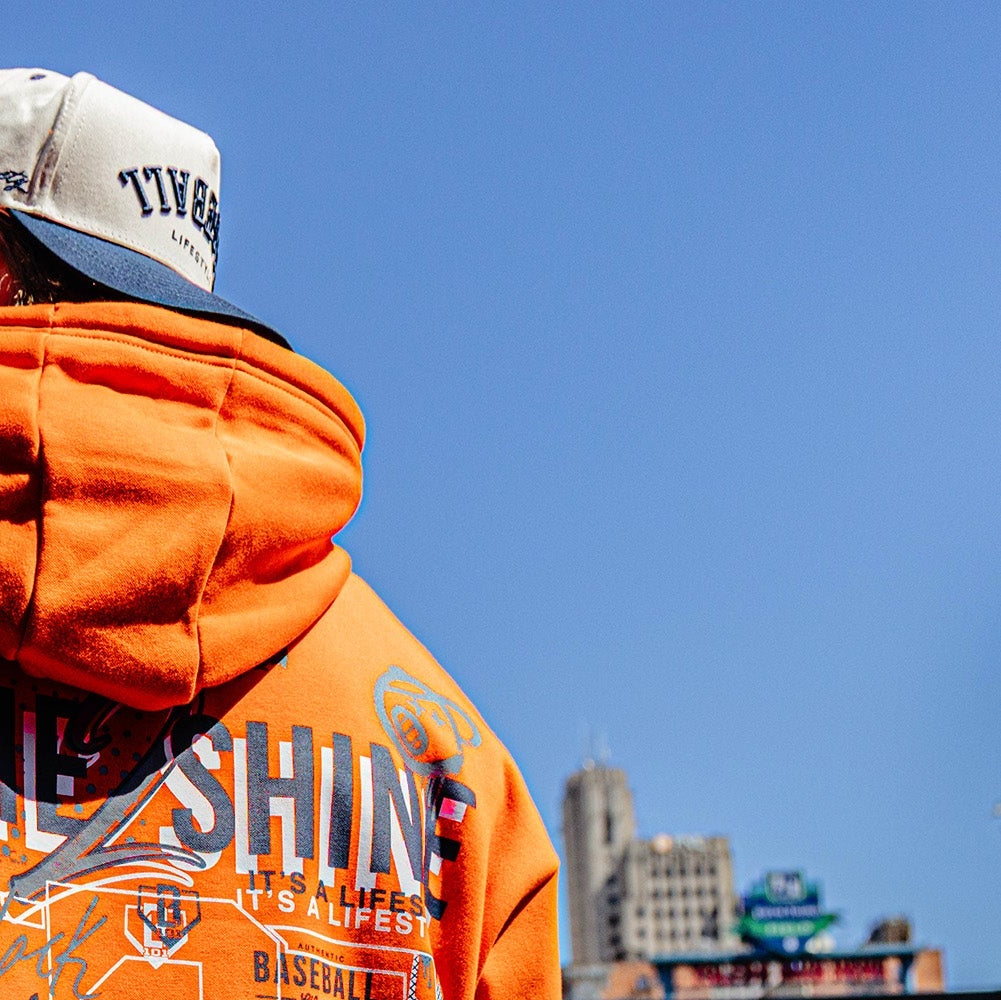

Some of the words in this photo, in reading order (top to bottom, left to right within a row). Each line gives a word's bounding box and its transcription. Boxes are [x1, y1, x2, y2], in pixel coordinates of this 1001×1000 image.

[159, 712, 478, 921] SHINE
[236, 888, 297, 913] IT'S
[306, 895, 321, 920] A
[327, 902, 433, 939] LIFEST
[339, 885, 425, 917] LIFES
